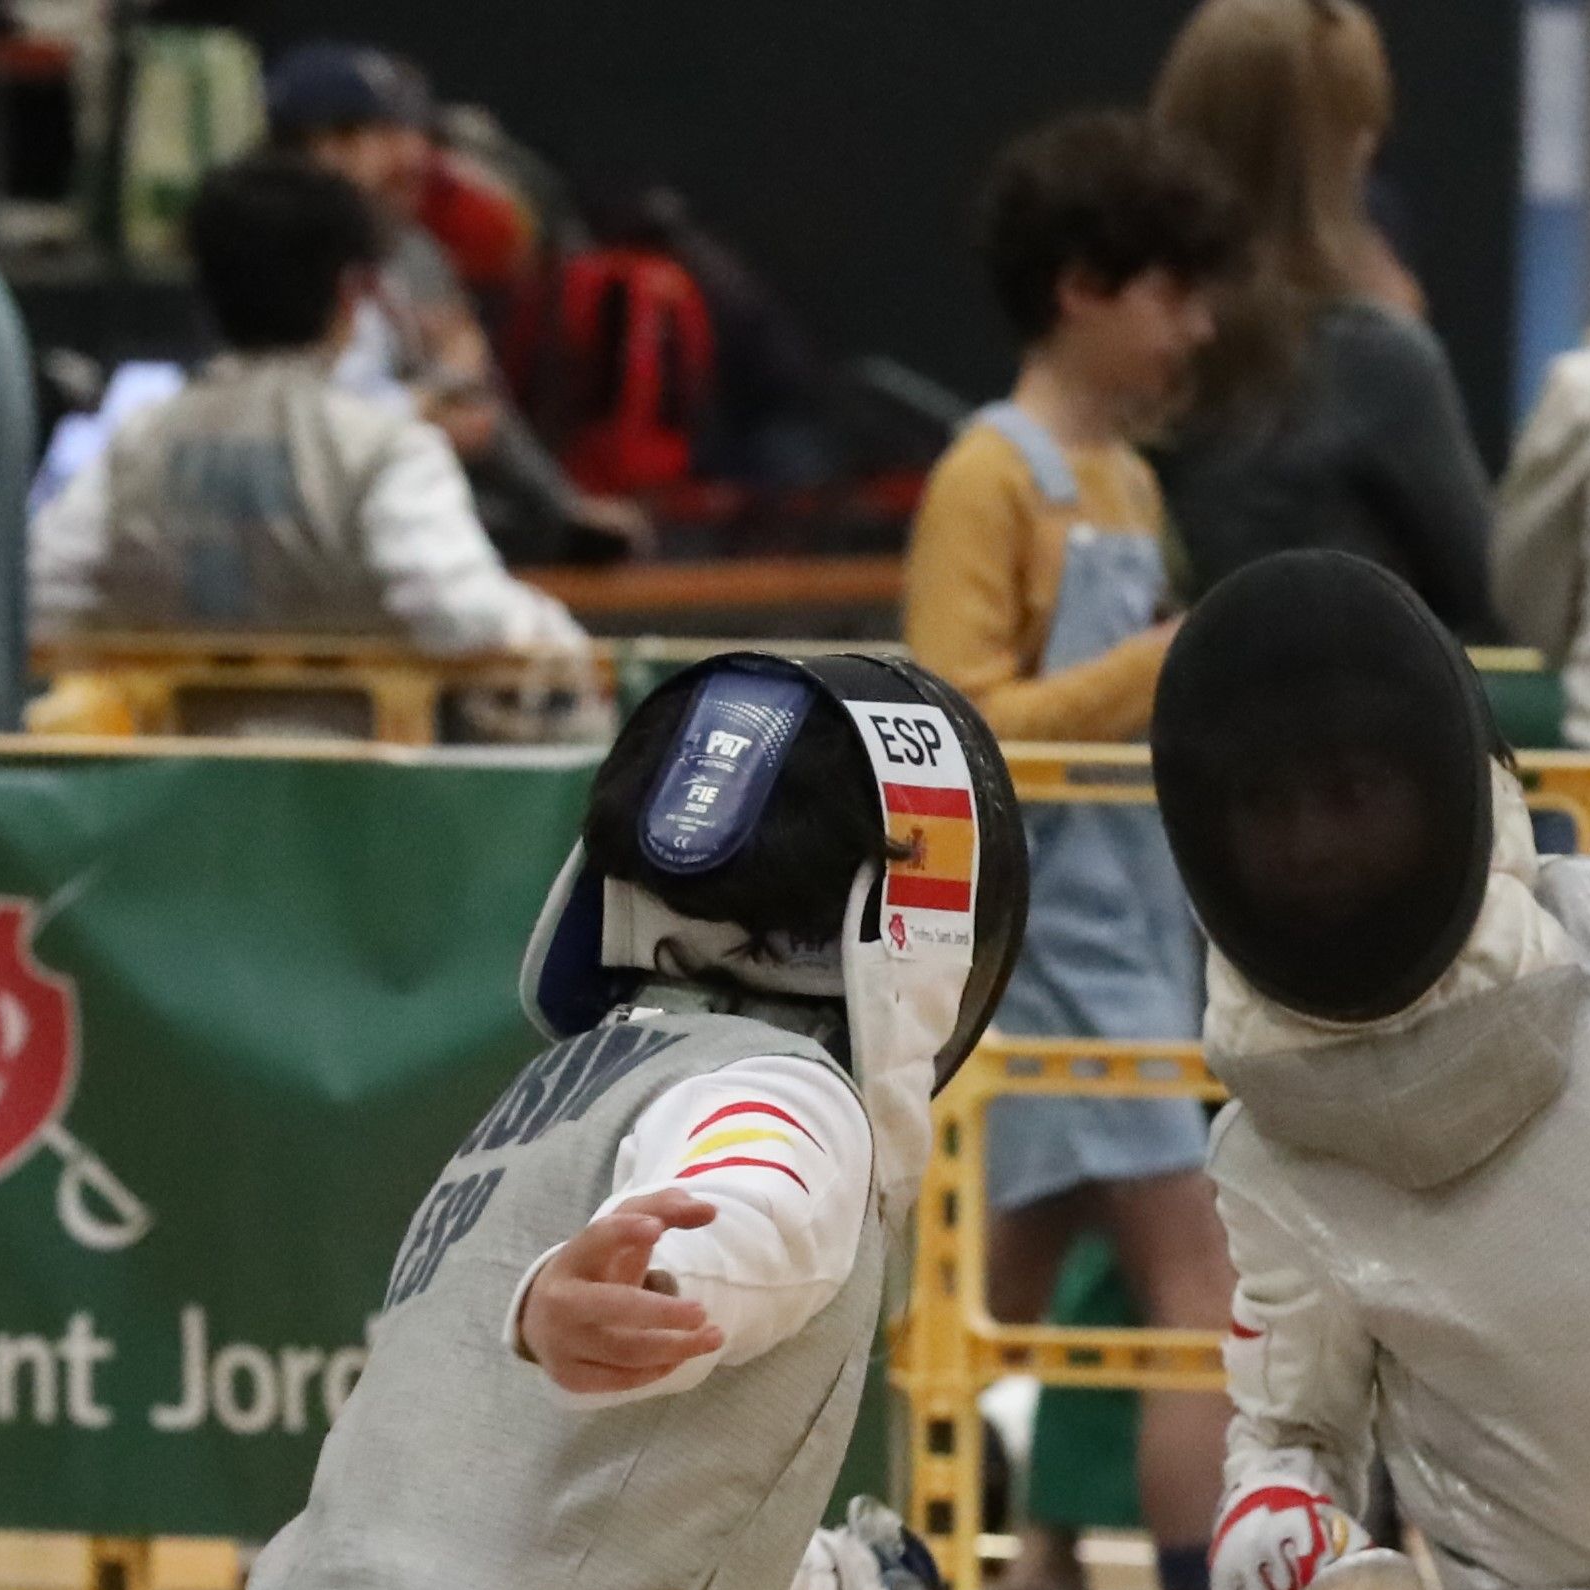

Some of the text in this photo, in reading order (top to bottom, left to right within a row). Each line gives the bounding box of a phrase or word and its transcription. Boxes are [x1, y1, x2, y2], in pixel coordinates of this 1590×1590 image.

[868, 714, 942, 768] ESP
[686, 783, 720, 804] FIE
[384, 1167, 507, 1305] ESP
